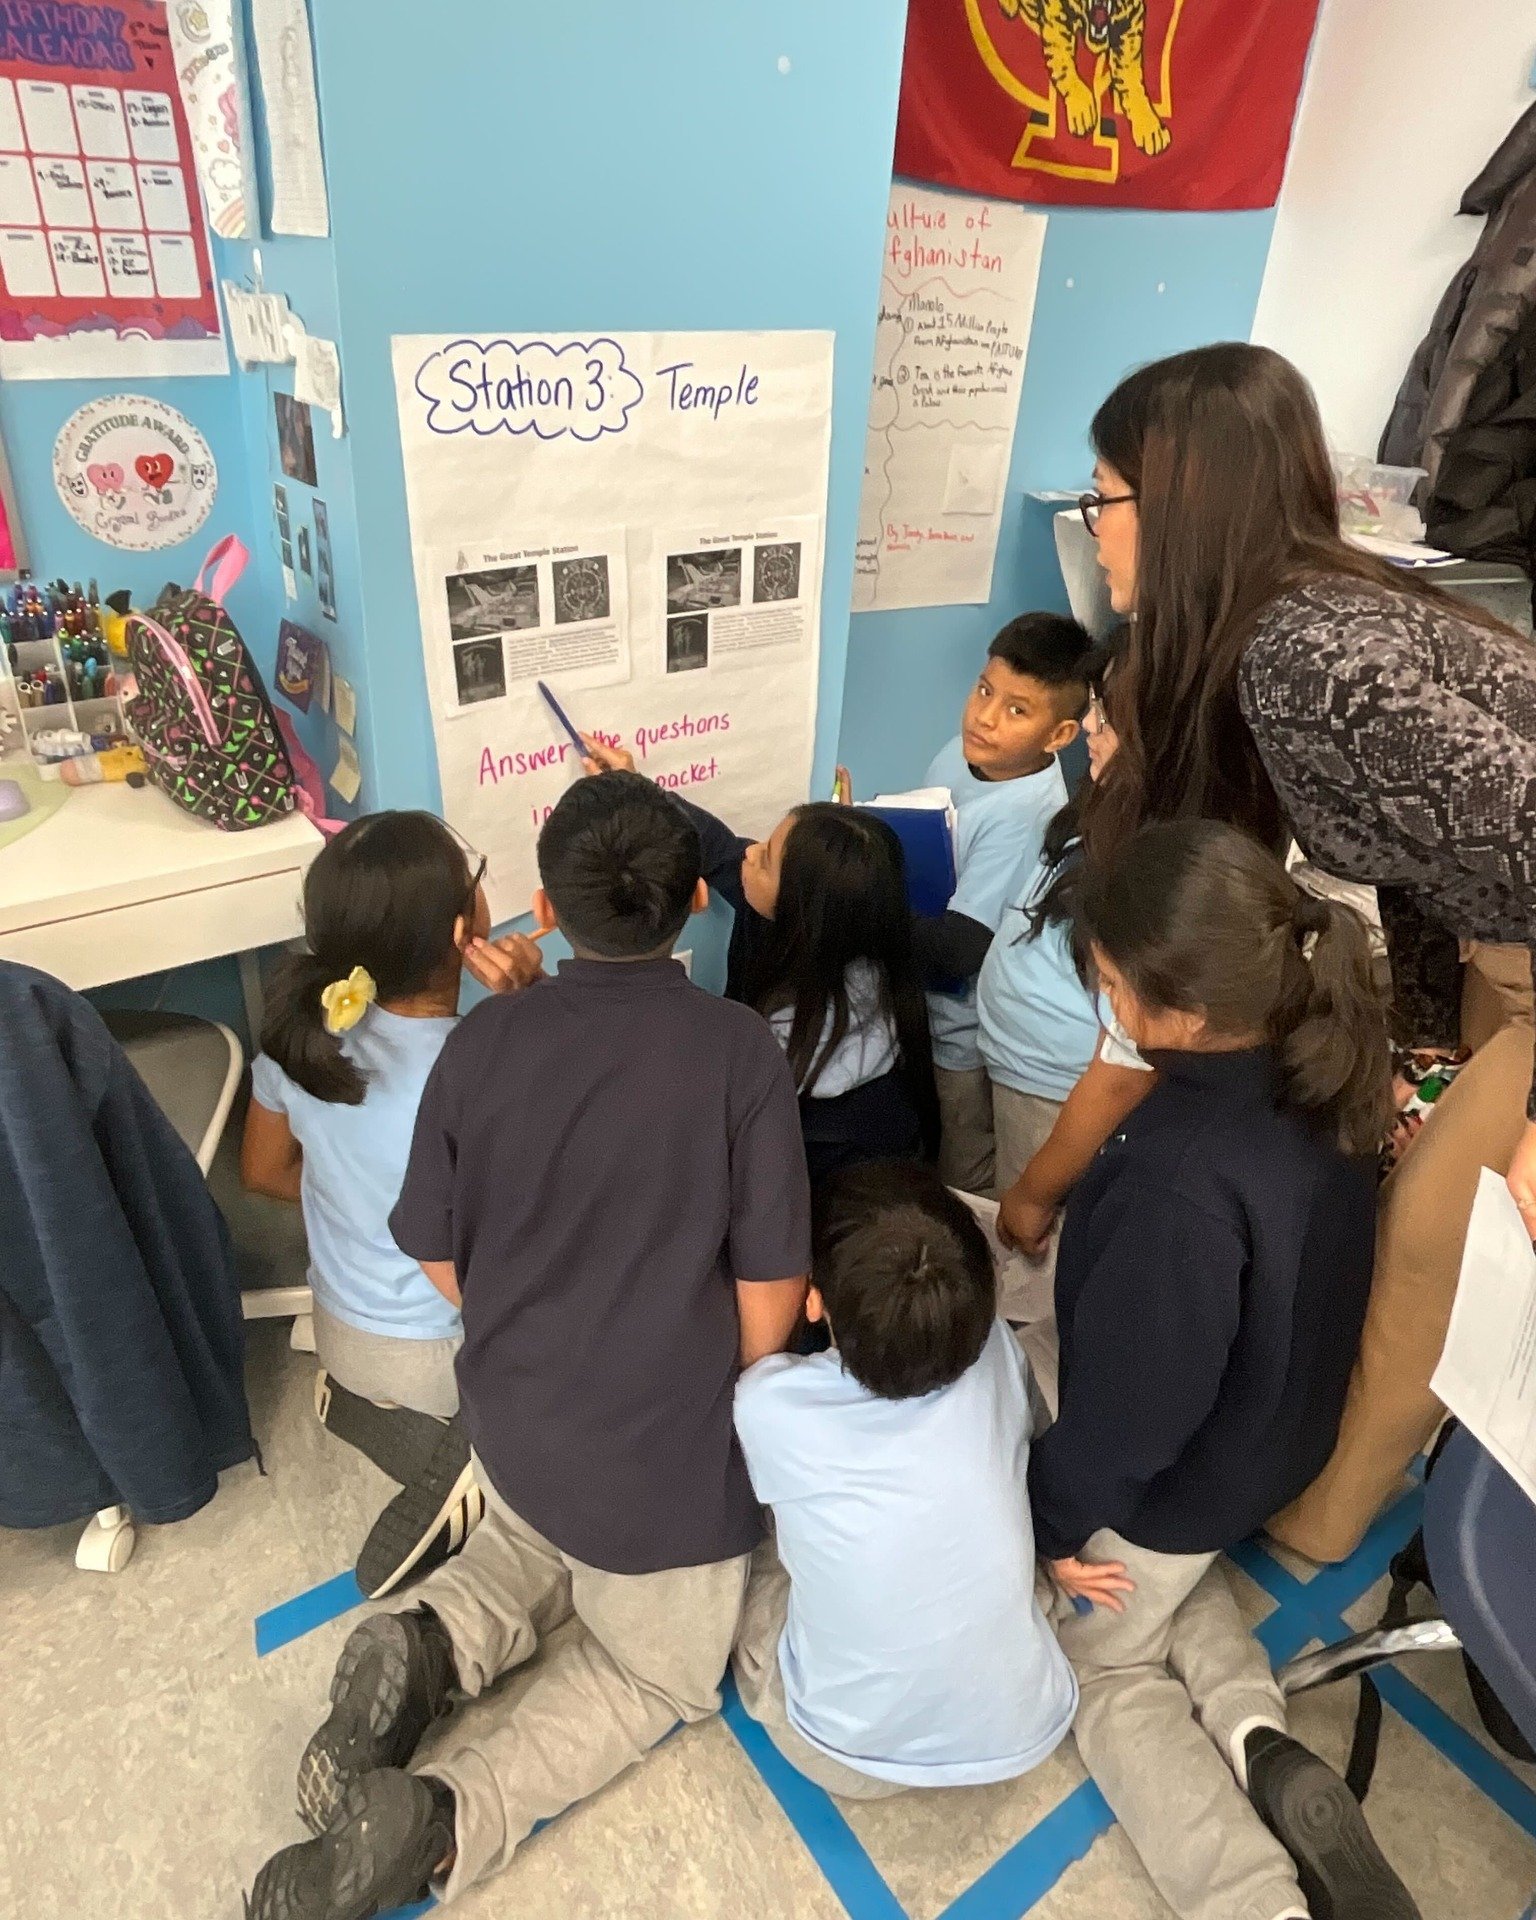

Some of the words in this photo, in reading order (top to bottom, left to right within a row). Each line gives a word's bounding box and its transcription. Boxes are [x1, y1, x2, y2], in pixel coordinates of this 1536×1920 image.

[0, 0, 124, 38] IRTHDAY
[966, 206, 991, 232] of
[889, 235, 1001, 278] fghanistan
[449, 358, 573, 413] Station
[585, 358, 615, 412] 3:
[656, 362, 759, 421] Temple
[141, 416, 190, 454] AWARD
[483, 554, 498, 563] The
[500, 551, 521, 561] Great
[523, 548, 550, 559] Temple
[552, 545, 579, 554] Station
[480, 743, 572, 785] Answer
[635, 713, 730, 759] questions
